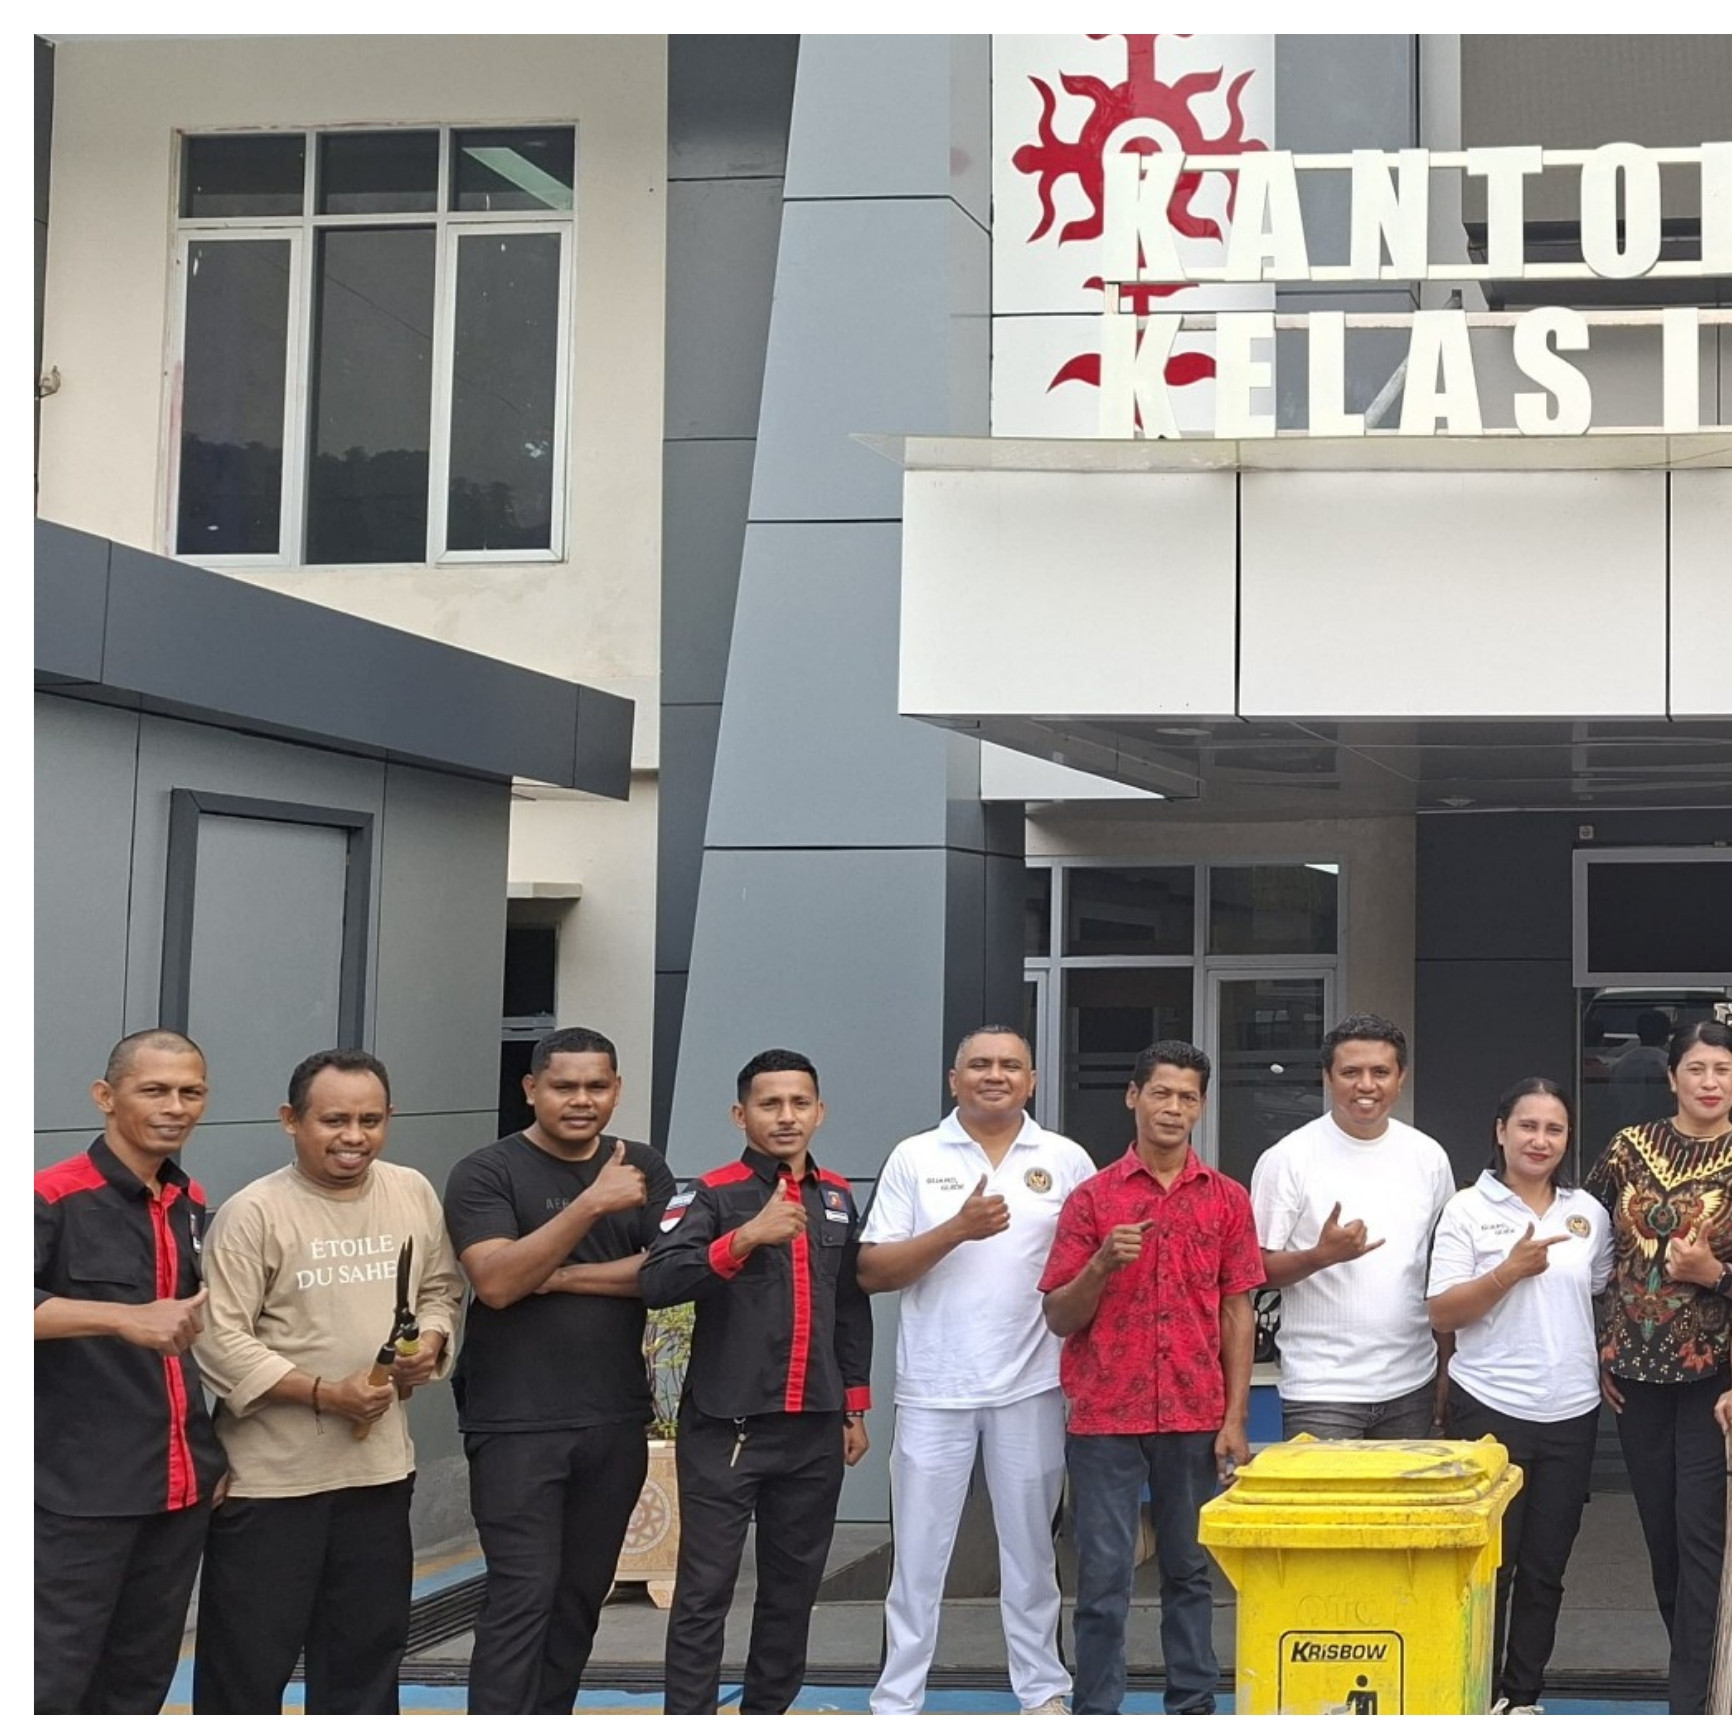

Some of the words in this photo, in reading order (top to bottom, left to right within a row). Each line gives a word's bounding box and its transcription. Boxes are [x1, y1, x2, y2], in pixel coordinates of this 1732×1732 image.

[1098, 306, 1593, 440] KELAS
[1662, 307, 1699, 433] I
[310, 1234, 395, 1259] ÉTOILE
[296, 1266, 333, 1290] DU
